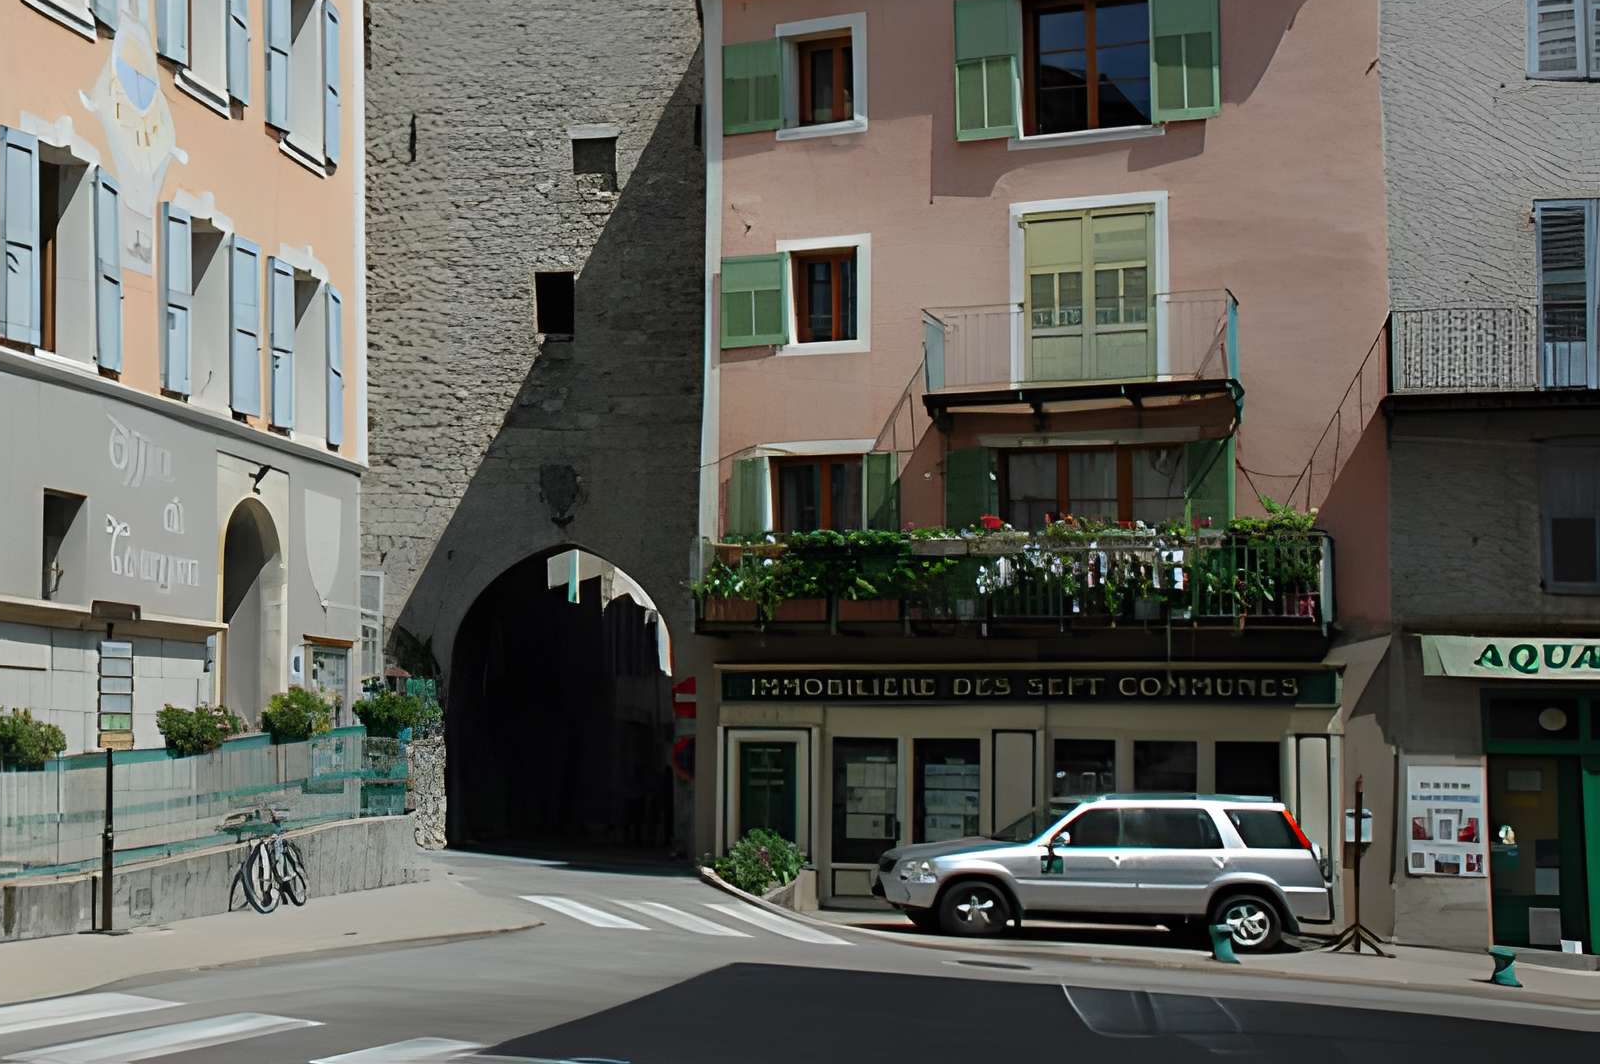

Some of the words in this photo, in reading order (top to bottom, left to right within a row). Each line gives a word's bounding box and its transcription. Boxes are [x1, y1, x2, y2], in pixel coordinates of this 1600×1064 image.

[953, 677, 1011, 696] DES
[1026, 677, 1104, 696] SEPT
[1118, 676, 1298, 697] COMMUNES
